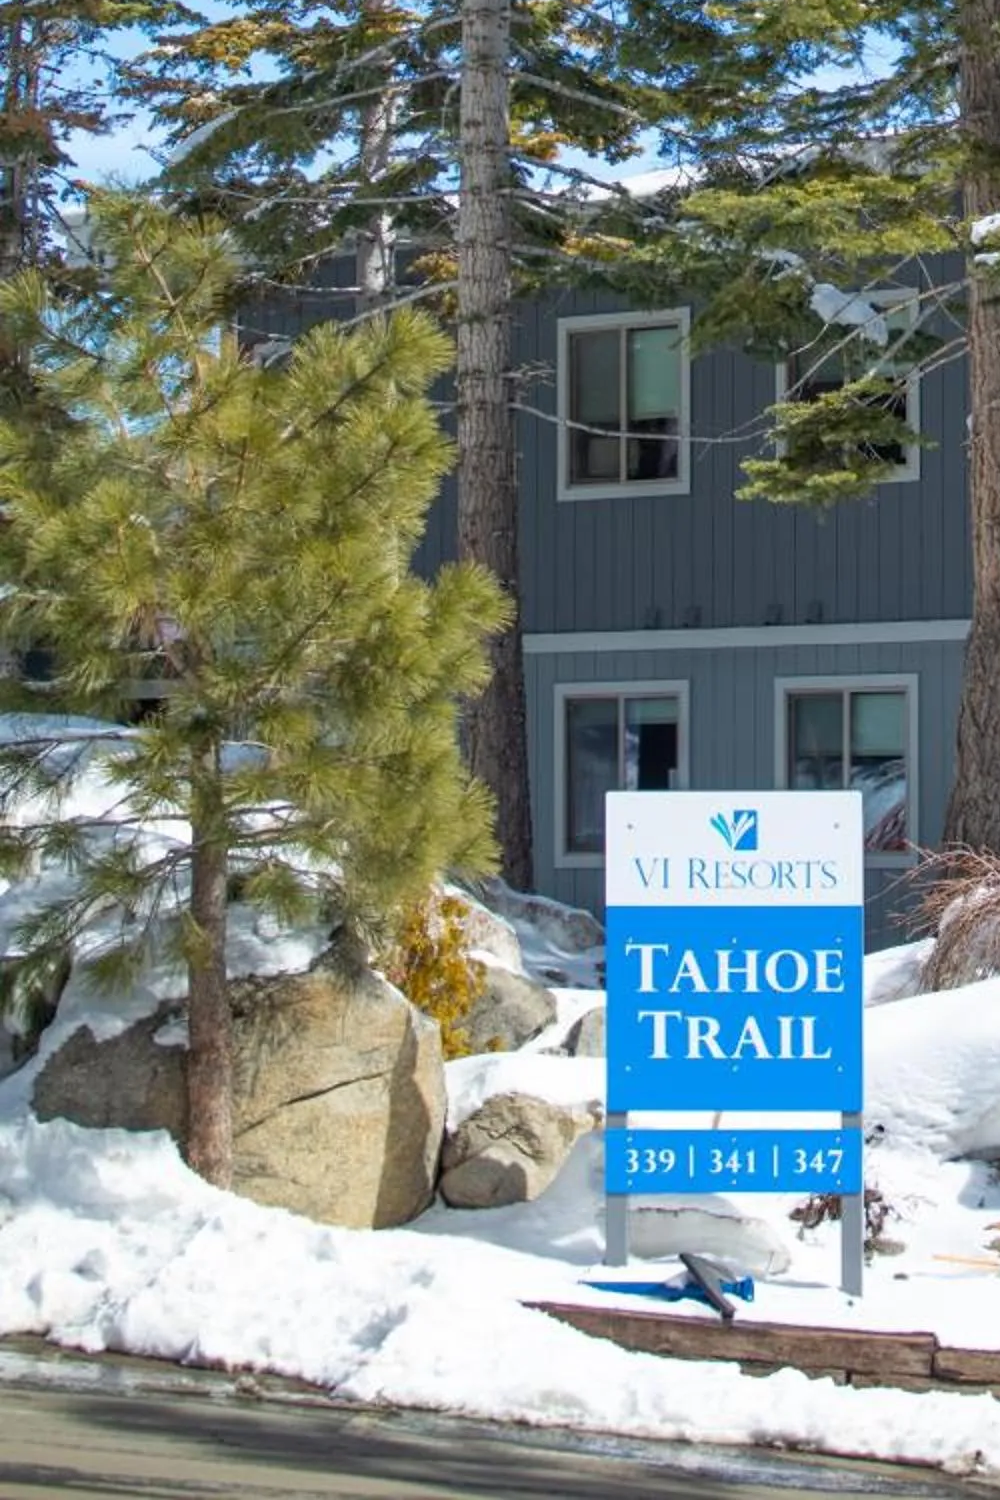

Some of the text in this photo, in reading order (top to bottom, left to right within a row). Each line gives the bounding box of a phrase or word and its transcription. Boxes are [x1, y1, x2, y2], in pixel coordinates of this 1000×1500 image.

[634, 858, 838, 889] VI RESORTS
[625, 943, 844, 993] TAHOE
[638, 1010, 832, 1060] TRAIL
[626, 1149, 676, 1173] 339
[709, 1149, 756, 1173] 341
[794, 1149, 844, 1173] 347
